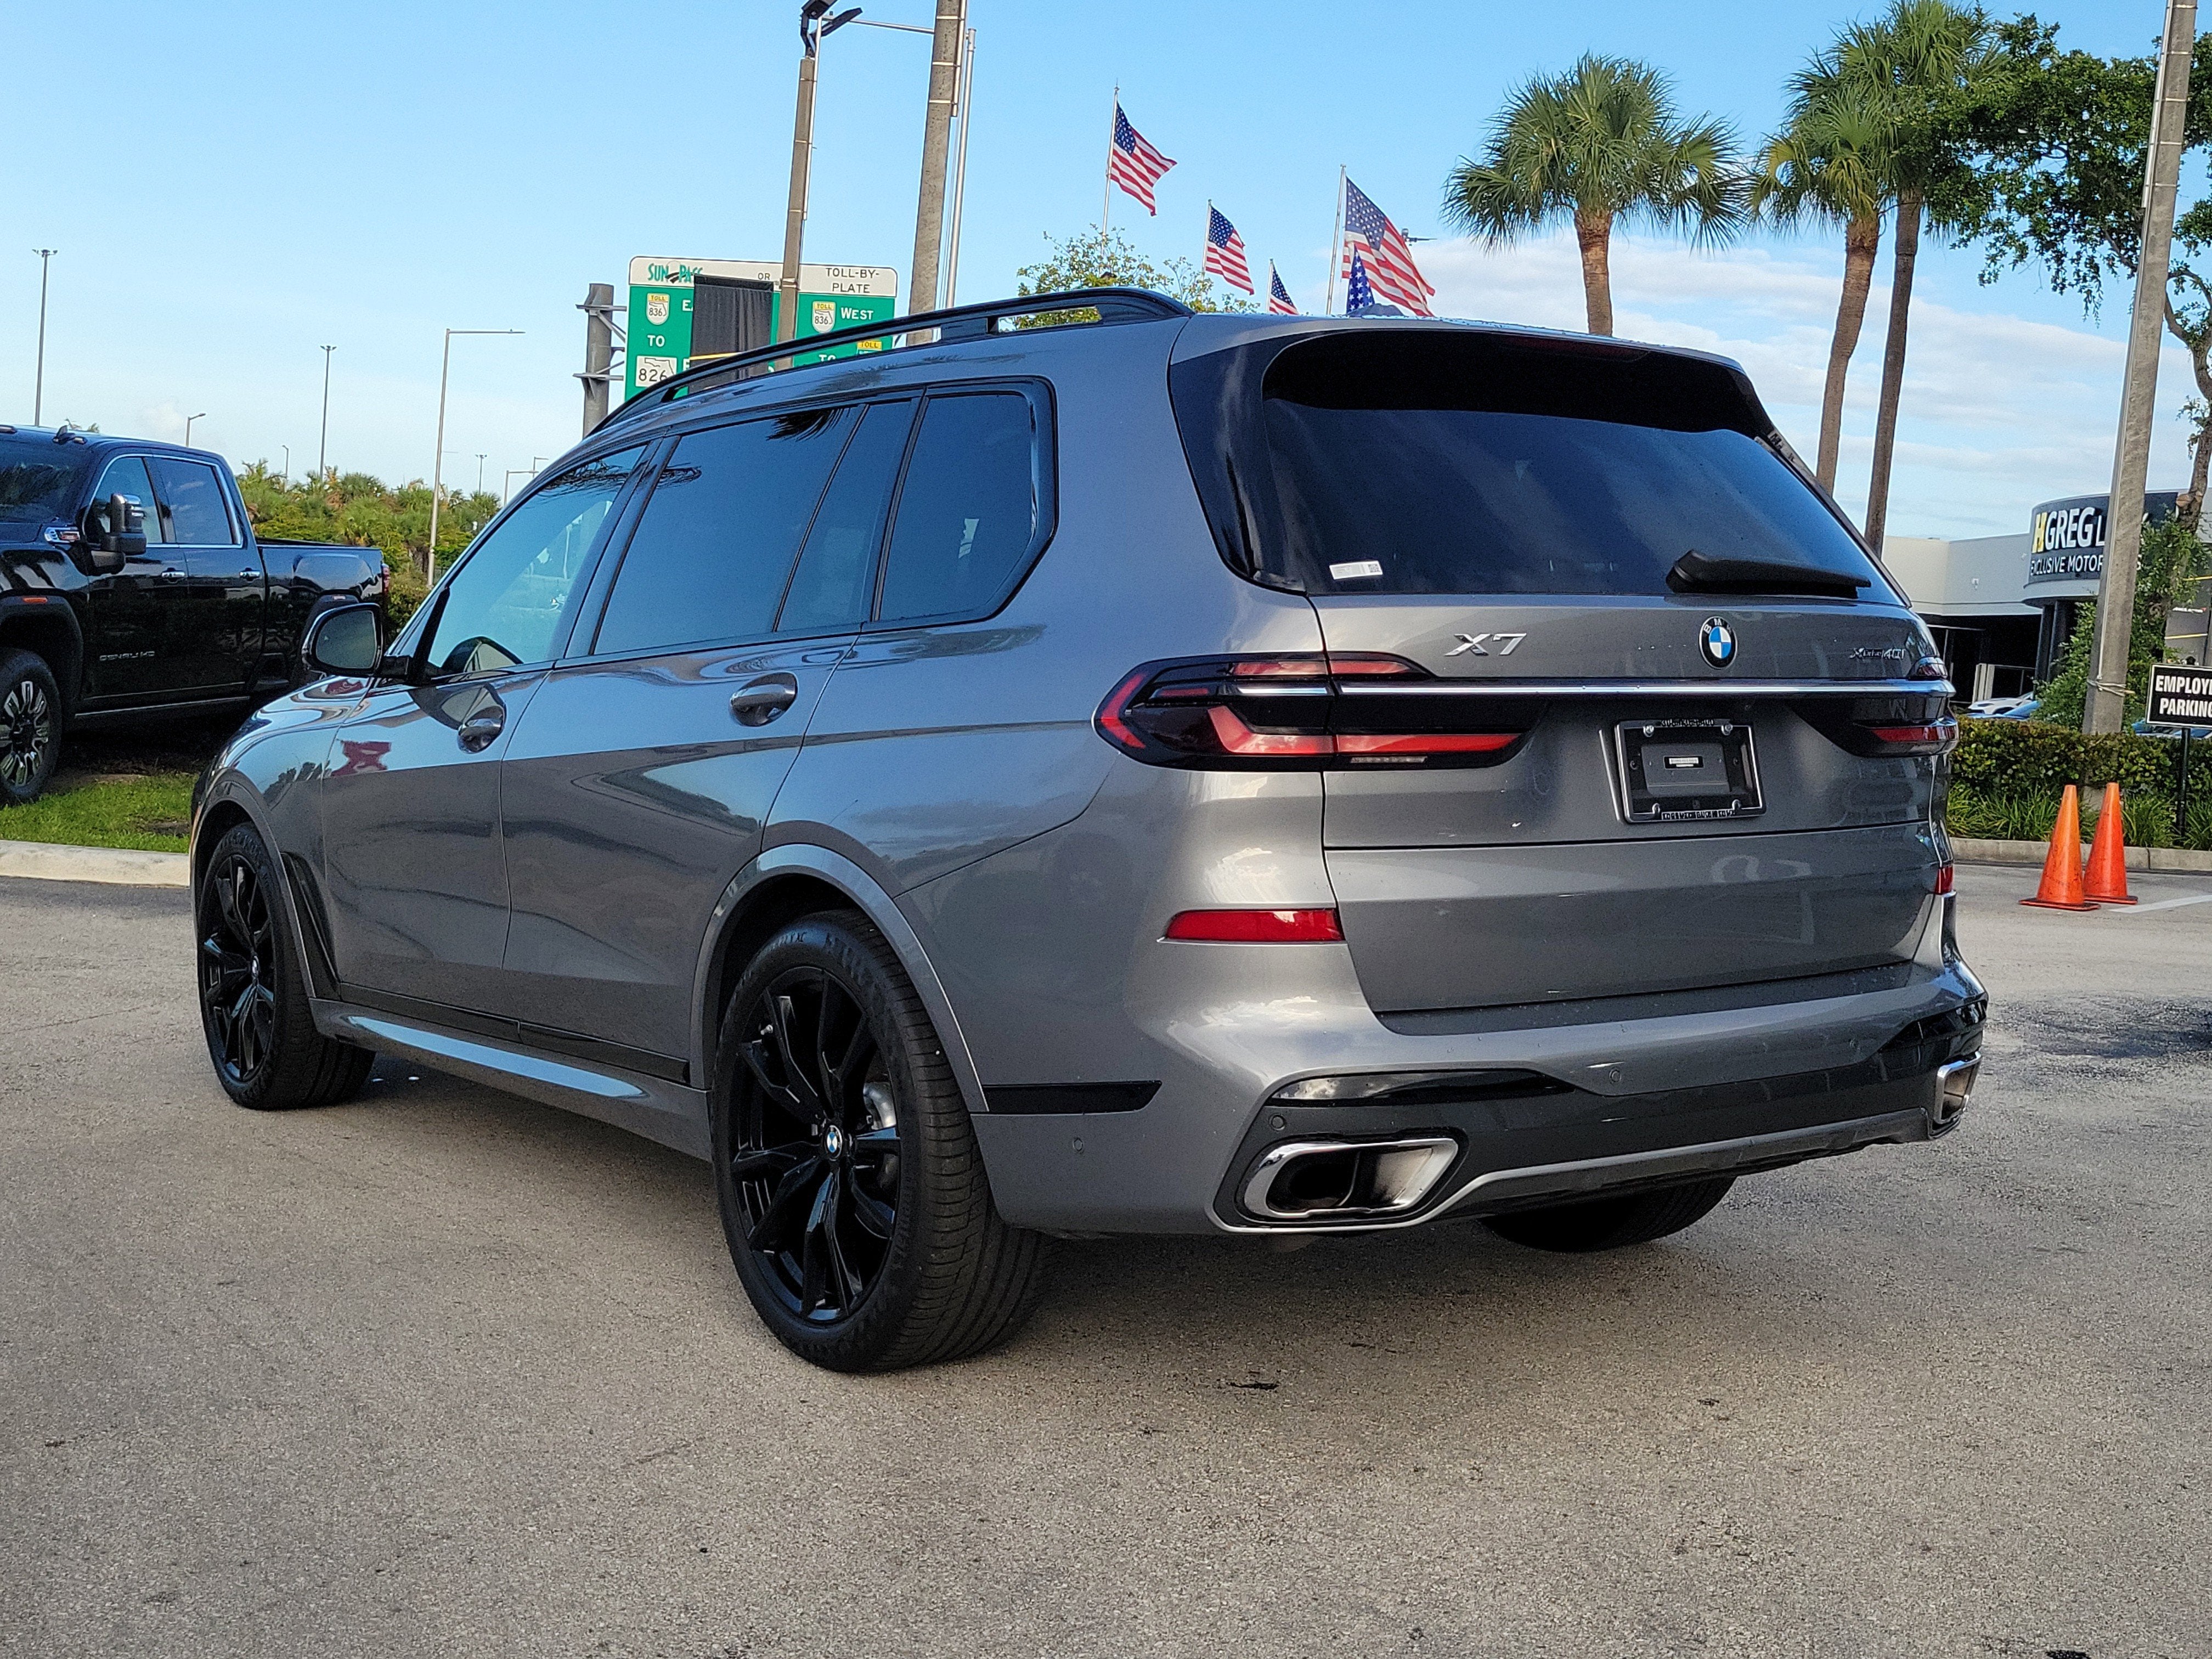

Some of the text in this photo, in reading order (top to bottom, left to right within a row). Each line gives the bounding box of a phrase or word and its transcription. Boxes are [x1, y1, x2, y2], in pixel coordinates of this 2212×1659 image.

[758, 272, 771, 280] OR
[826, 268, 880, 279] TOLL-BY-
[832, 283, 871, 294] PLATE
[648, 307, 663, 317] 836
[840, 307, 874, 320] WEST
[814, 315, 829, 325] 836
[647, 335, 665, 347] TO
[639, 368, 667, 382] 826
[1444, 633, 1527, 656] X7
